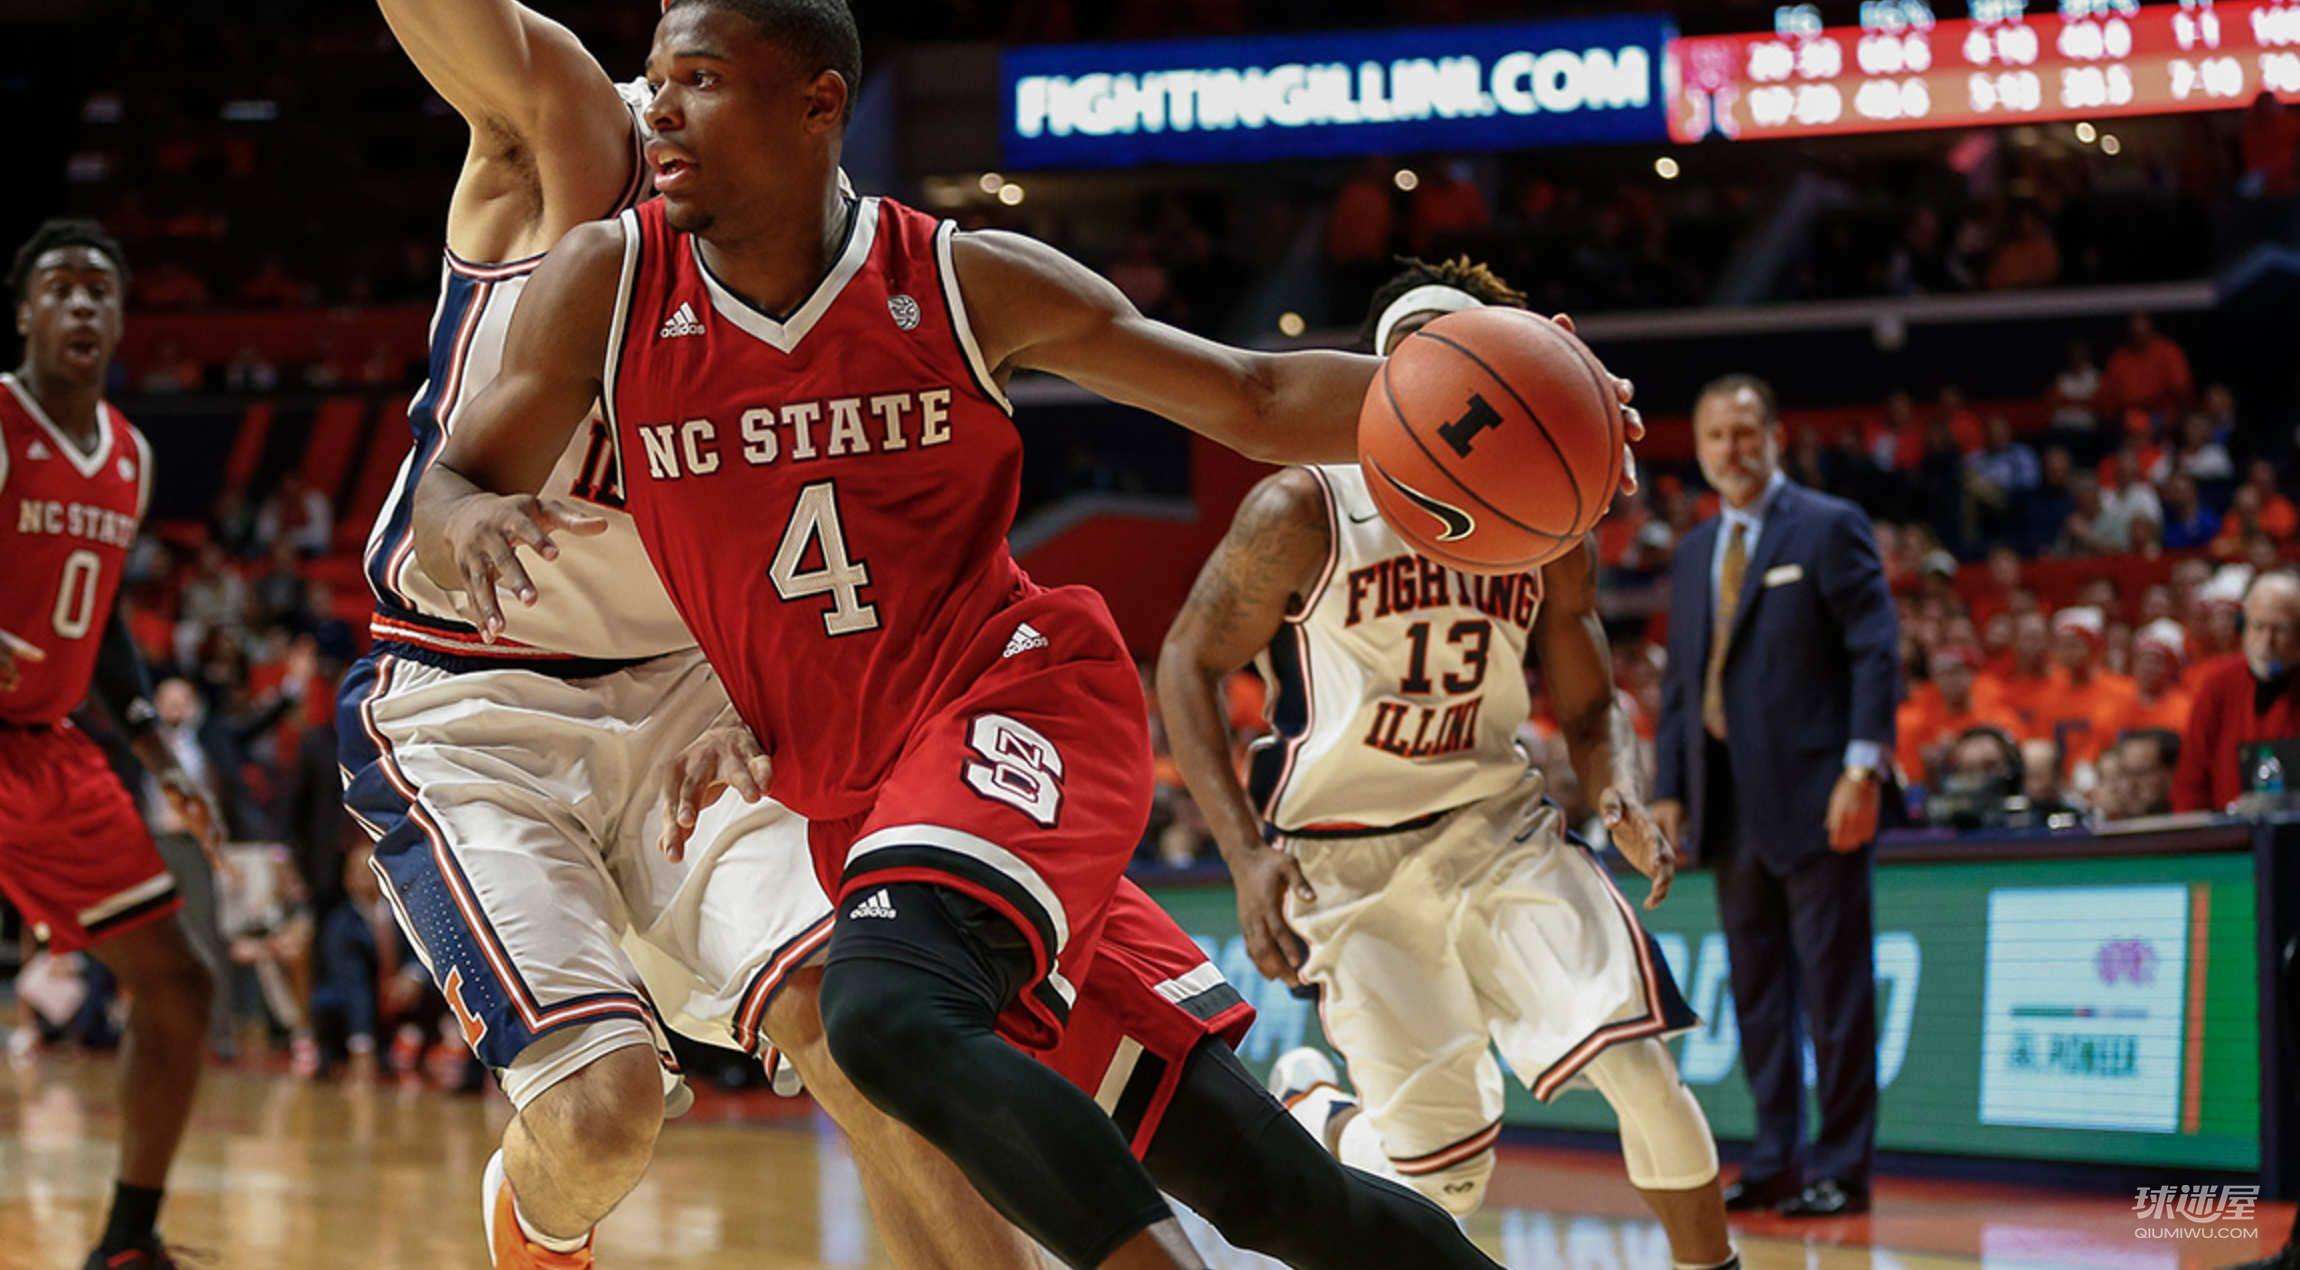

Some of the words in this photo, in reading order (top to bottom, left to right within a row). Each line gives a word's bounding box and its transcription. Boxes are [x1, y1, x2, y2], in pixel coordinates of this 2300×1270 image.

[1016, 46, 1650, 138] FIGHTINGILLINI.COM
[638, 418, 721, 479] NC
[740, 388, 952, 465] STATE
[1437, 394, 1504, 459] I
[17, 498, 64, 534] NC
[52, 549, 101, 640] 0
[768, 480, 880, 637] 4
[1400, 619, 1492, 696] 13
[1363, 697, 1481, 758] ILLINI
